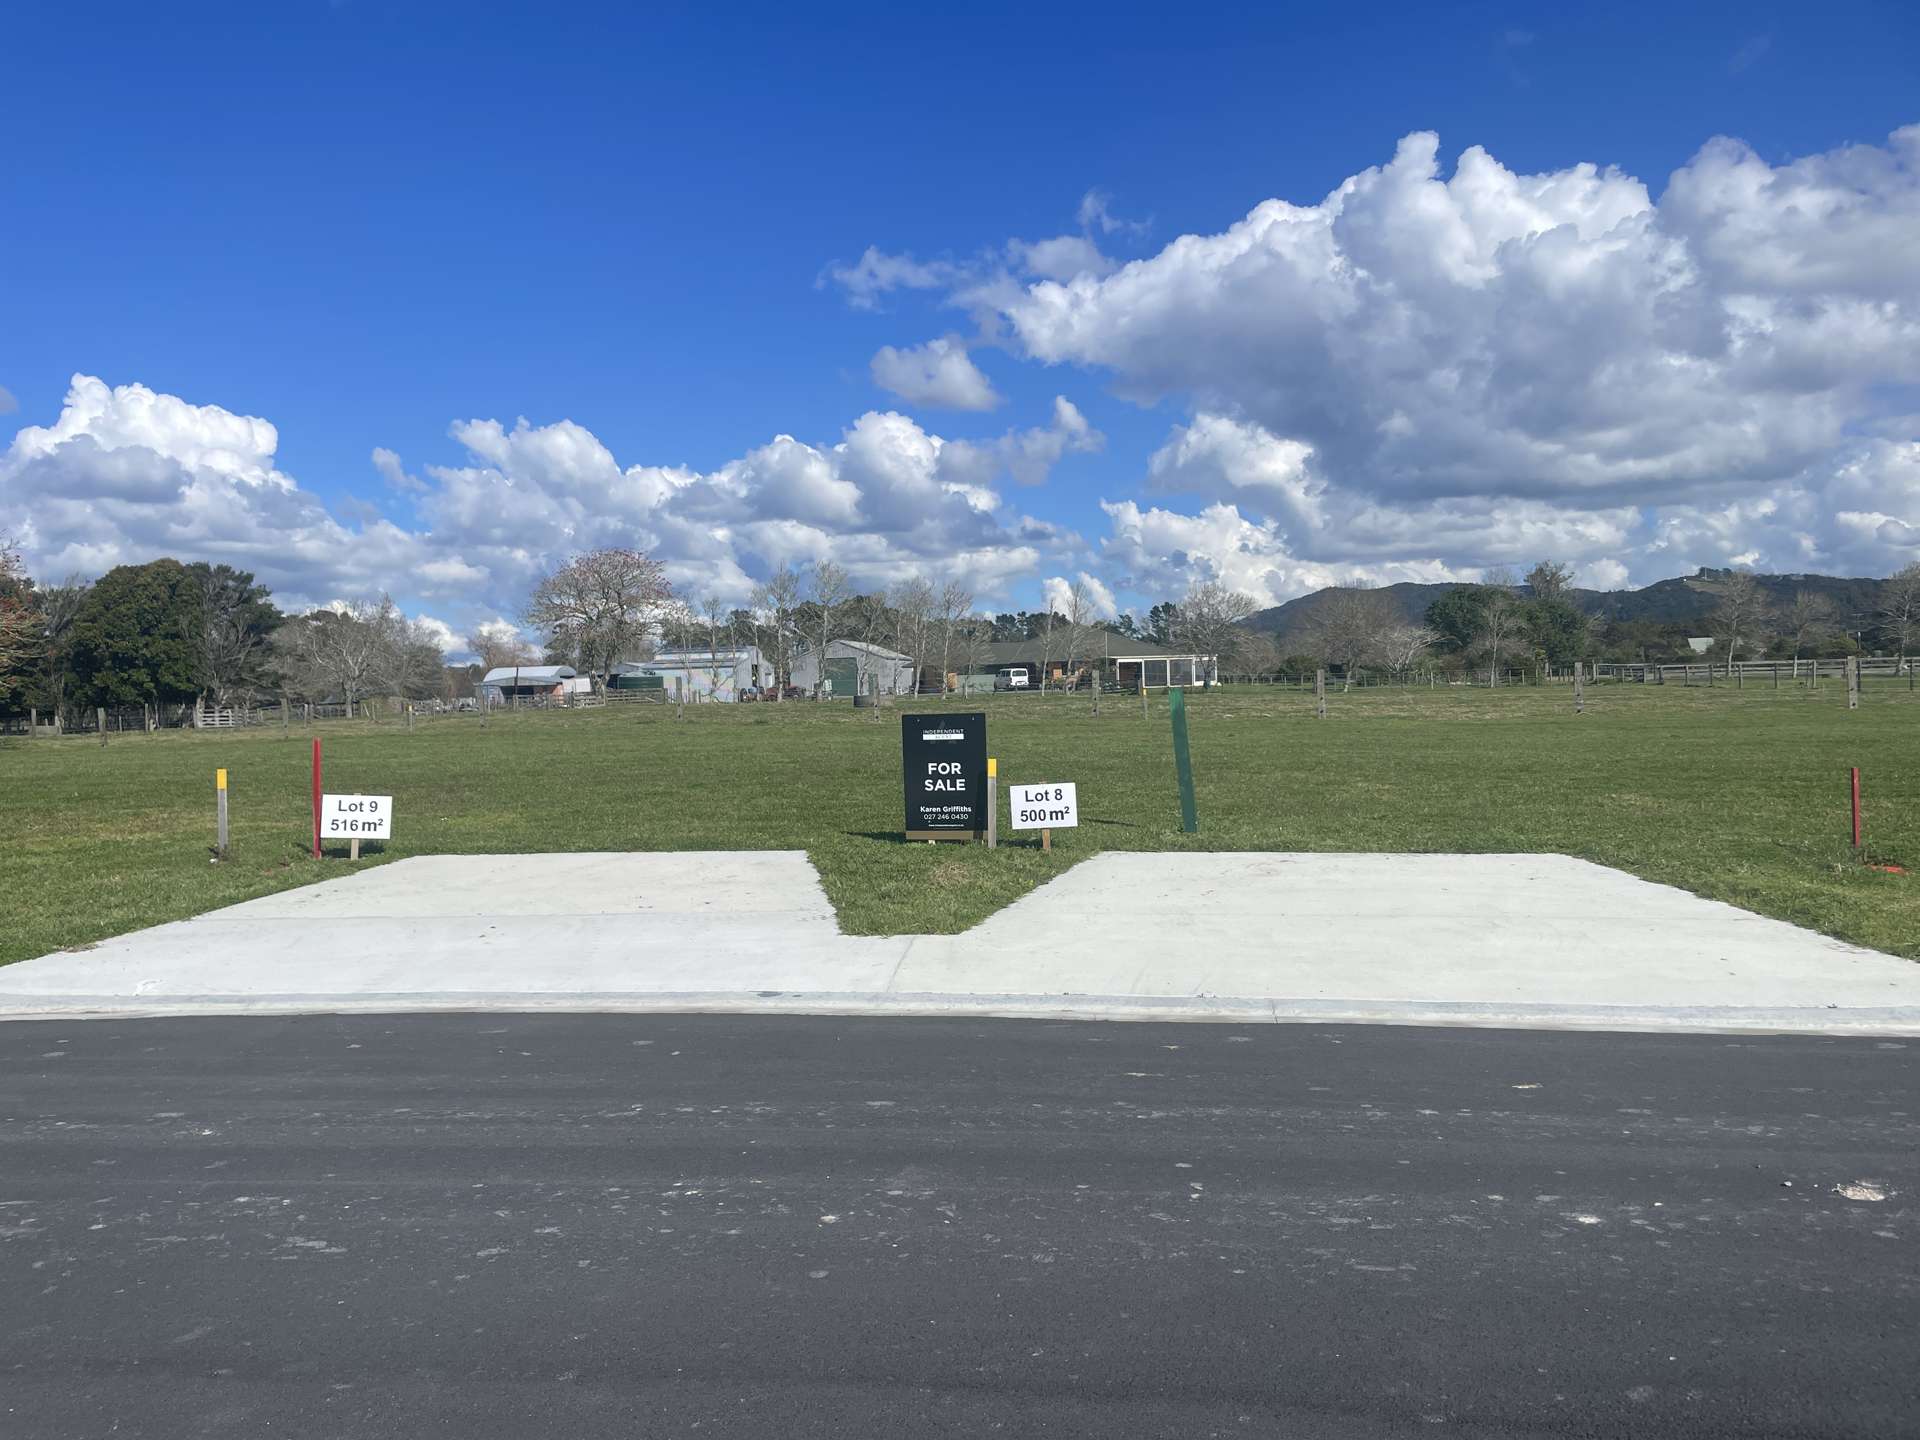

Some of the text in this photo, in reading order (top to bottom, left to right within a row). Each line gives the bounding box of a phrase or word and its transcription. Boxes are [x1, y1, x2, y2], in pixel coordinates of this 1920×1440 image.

[928, 762, 962, 775] FOR
[924, 779, 966, 791] SALE
[1025, 788, 1063, 802] Lot 8
[338, 799, 378, 813] Lot 9
